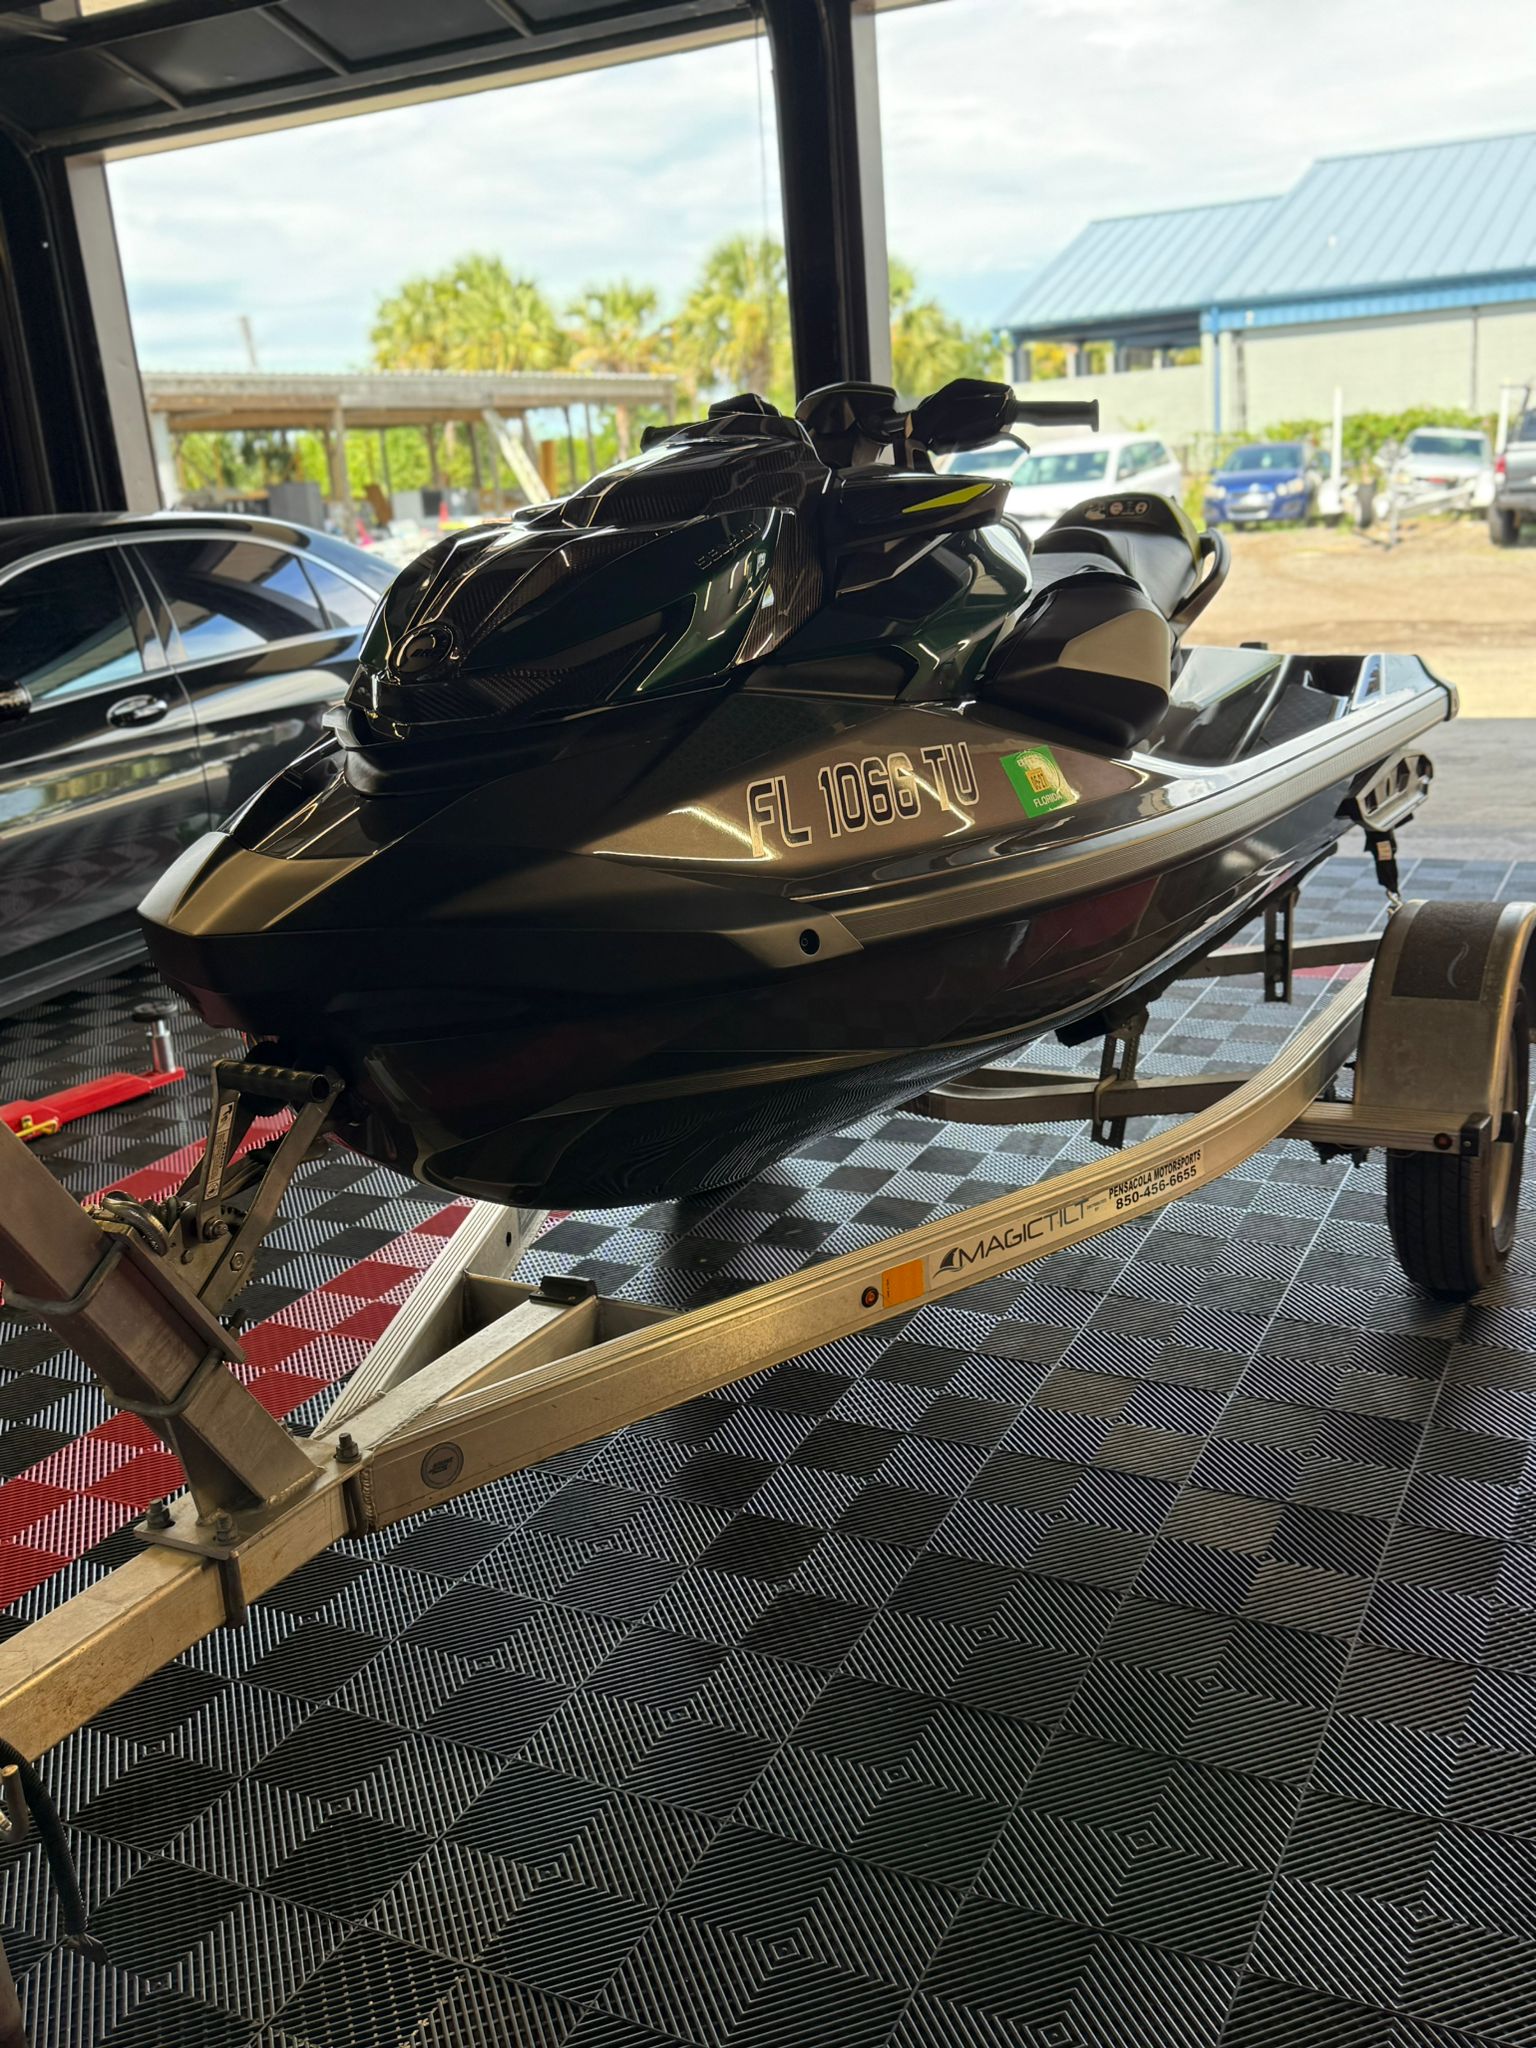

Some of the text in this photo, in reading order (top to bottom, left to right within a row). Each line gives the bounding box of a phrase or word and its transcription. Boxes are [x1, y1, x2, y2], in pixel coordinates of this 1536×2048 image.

[746, 741, 980, 857] FL 1066 TU
[1033, 793, 1063, 808] FLORIDA
[1108, 1149, 1201, 1199] PENSACOLA MOTORSPORTS
[1115, 1165, 1198, 1210] 850-456-6655
